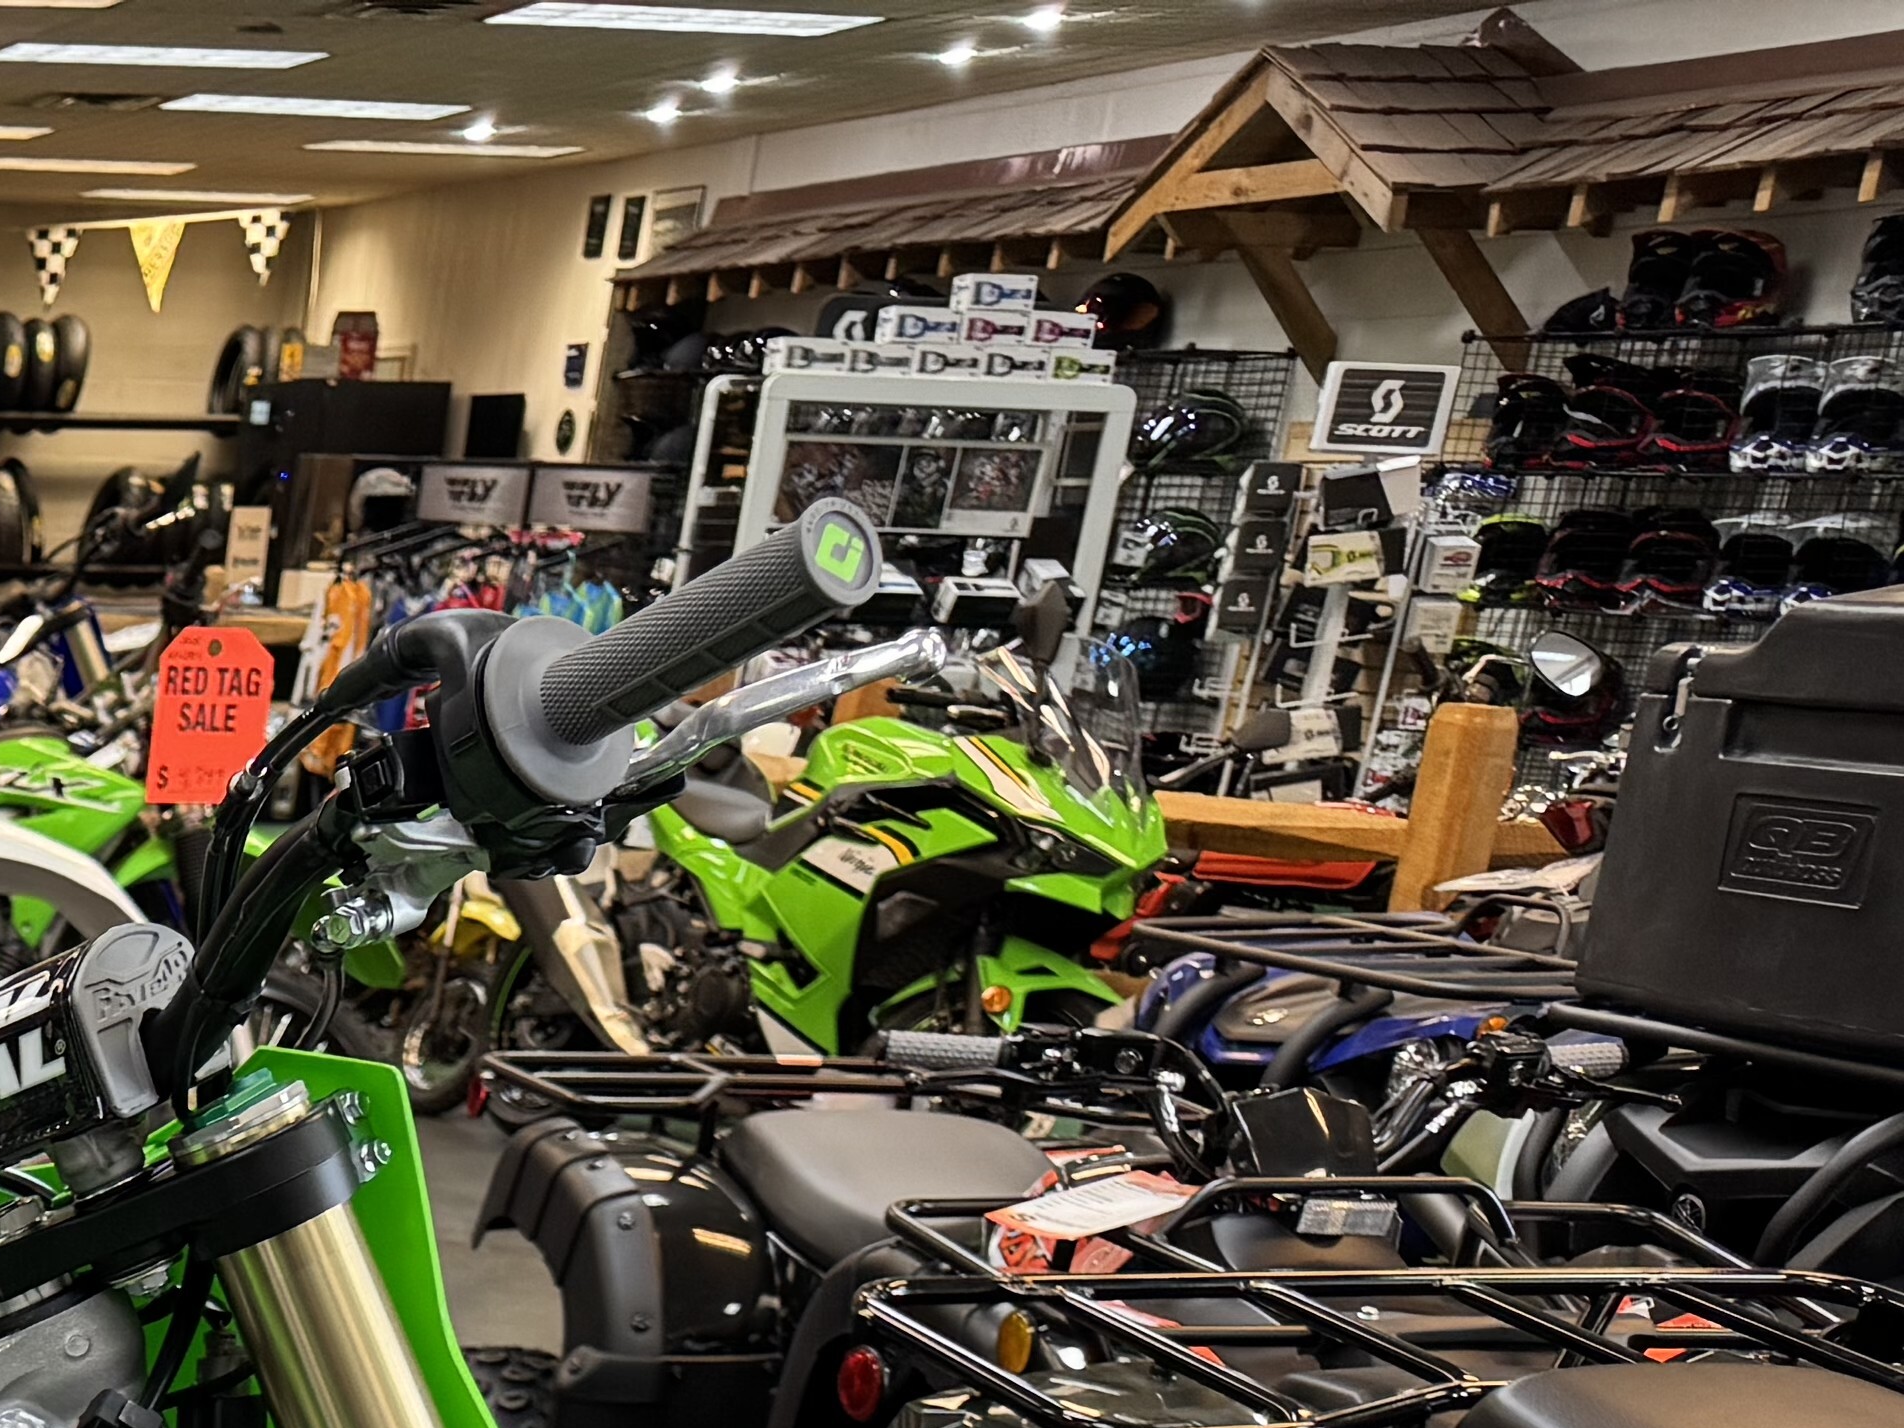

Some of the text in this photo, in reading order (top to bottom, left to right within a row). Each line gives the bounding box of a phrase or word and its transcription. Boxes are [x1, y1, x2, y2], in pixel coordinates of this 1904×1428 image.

[1334, 423, 1427, 439] SCOTT
[165, 665, 263, 697] RED TAG
[177, 702, 238, 733] SALE
